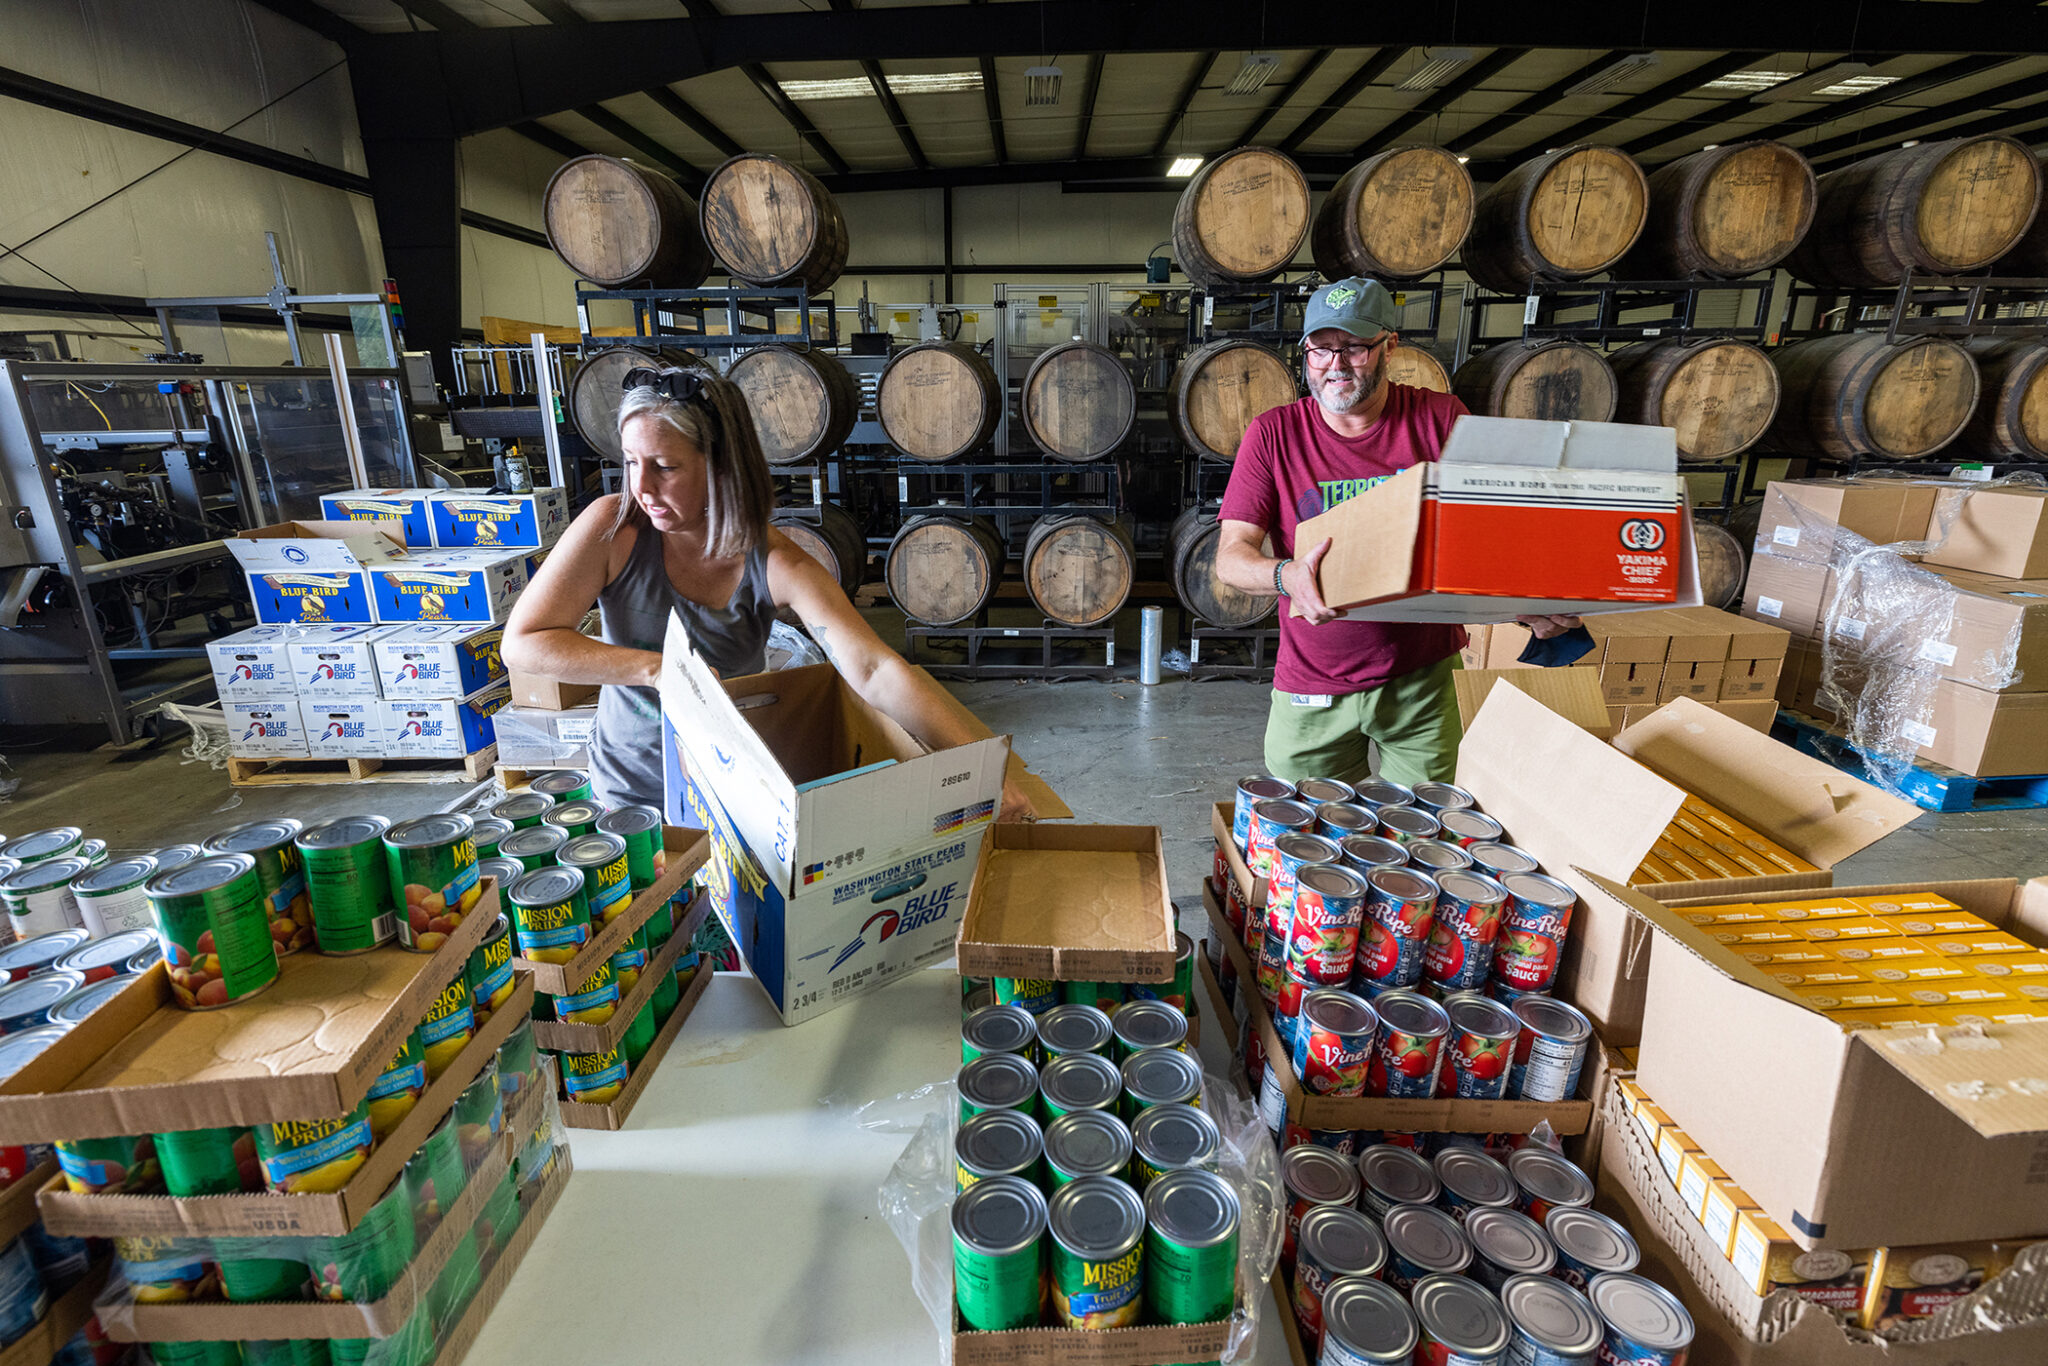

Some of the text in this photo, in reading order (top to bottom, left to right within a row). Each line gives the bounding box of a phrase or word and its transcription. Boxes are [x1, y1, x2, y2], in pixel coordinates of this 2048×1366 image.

[1462, 478, 1515, 488] AMERICAN
[1519, 481, 1547, 489] HOPS
[1618, 485, 1663, 494] NORTHWEST
[378, 513, 403, 521] BIRD
[458, 513, 511, 522] BLUE BIRD
[473, 536, 505, 546] Pears
[1616, 554, 1669, 566] YAKIMA
[1621, 565, 1663, 577] CHIEF
[280, 587, 339, 597] BLUE BIRD
[400, 585, 459, 595] BLUE BIRD
[299, 612, 334, 623] Pears
[417, 610, 453, 621] Pears
[475, 646, 492, 661] BLUE
[252, 664, 275, 672] BLUE
[418, 663, 441, 671] BLUE
[252, 672, 275, 680] BIRD
[334, 671, 355, 680] BIRD
[418, 671, 440, 679] BIRD
[482, 706, 499, 719] BLUE
[266, 721, 288, 729] BLUE
[344, 722, 365, 730] BLUE
[422, 721, 443, 729] BLUE
[266, 729, 287, 737] BIRD
[344, 729, 365, 738] BIRD
[422, 728, 442, 736] BIRD
[687, 783, 750, 894] BLUE BIRD
[774, 815, 790, 863] CAT.
[834, 841, 967, 896] WASHINGTON STATE PEARS
[902, 881, 958, 917] BLUE
[517, 901, 574, 926] MISSION
[896, 901, 948, 938] BIRD
[1304, 904, 1346, 927] Vine
[1376, 902, 1414, 934] Ripe
[1500, 906, 1537, 930] Vine
[528, 918, 565, 931] PRIDE
[1441, 904, 1480, 937] Ripe
[1126, 966, 1164, 976] USDA
[1319, 961, 1349, 974] Sauce
[1505, 962, 1540, 982] Sauce
[793, 998, 800, 1011] 2
[1535, 1037, 1560, 1049] Nutrition
[567, 1047, 619, 1073] MISSION
[1320, 1044, 1363, 1067] Vine
[1531, 1053, 1554, 1065] Calories
[579, 1062, 613, 1076] PRIDE
[291, 1118, 348, 1147] PRIDE
[253, 1219, 301, 1232] USDA
[979, 1281, 989, 1290] 70
[1093, 1291, 1120, 1305] Fruit
